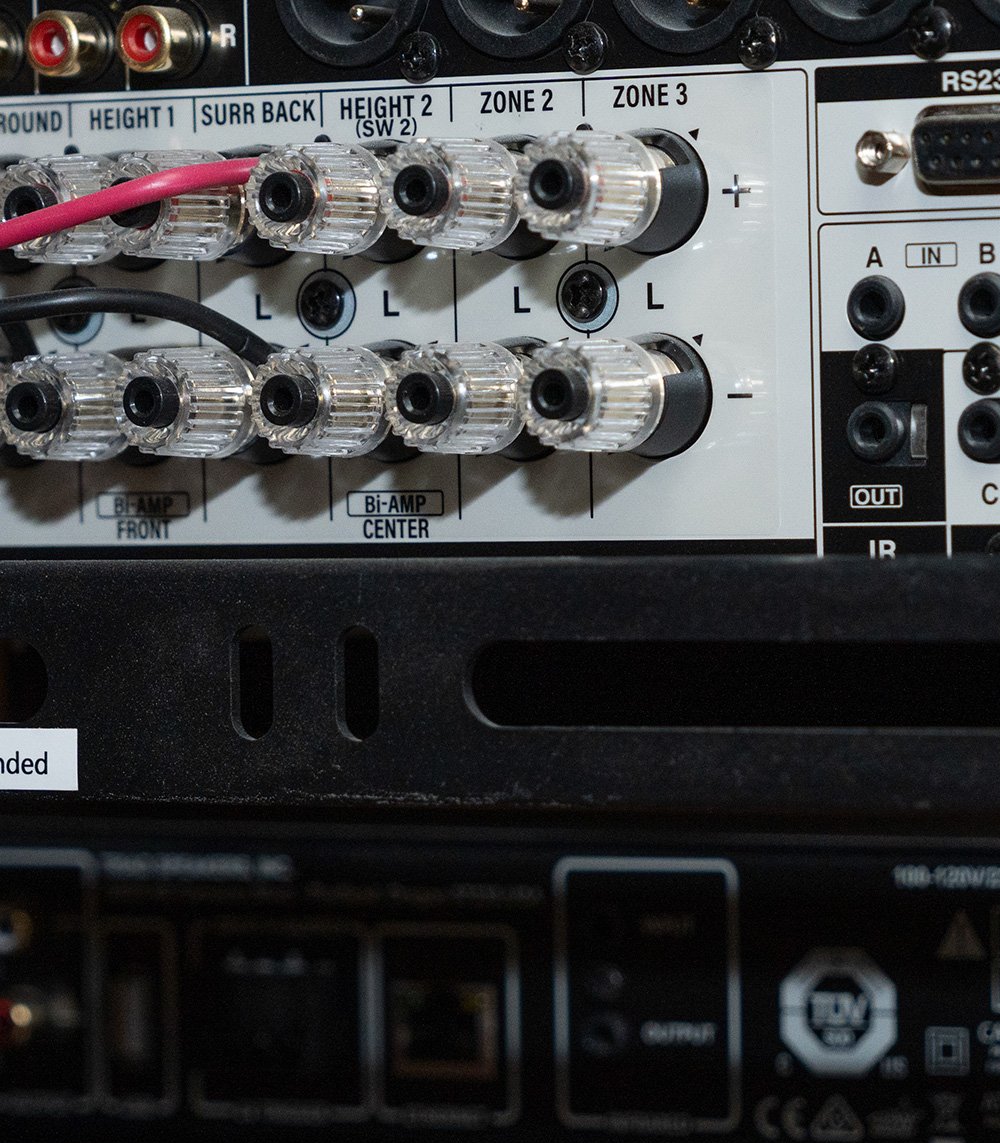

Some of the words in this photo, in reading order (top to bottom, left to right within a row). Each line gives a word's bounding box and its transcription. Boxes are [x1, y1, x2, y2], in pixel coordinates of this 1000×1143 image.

[220, 23, 236, 47] R
[340, 94, 415, 120] HEIGHT
[420, 93, 433, 117] 2
[480, 89, 536, 114] ZONE
[541, 88, 554, 111] 2
[612, 83, 671, 109] ZONE
[675, 82, 689, 106] 3
[89, 106, 161, 130] HEIGHT
[167, 106, 174, 128] 1
[201, 102, 255, 127] SURR
[262, 99, 316, 124] BACK
[355, 119, 396, 138] (SW
[399, 117, 418, 137] 2)
[866, 246, 884, 268] A
[921, 247, 941, 265] IN
[979, 243, 996, 264] B
[255, 293, 272, 320] L
[383, 290, 399, 317] L
[514, 286, 531, 313] L
[647, 282, 664, 310] L
[364, 495, 427, 513] Bi-AMP
[855, 488, 898, 505] OUT
[981, 483, 999, 505] C
[113, 496, 173, 515] Bi-AMP
[116, 519, 171, 540] FRONT
[362, 519, 429, 539] CENTER
[869, 540, 896, 559] IR
